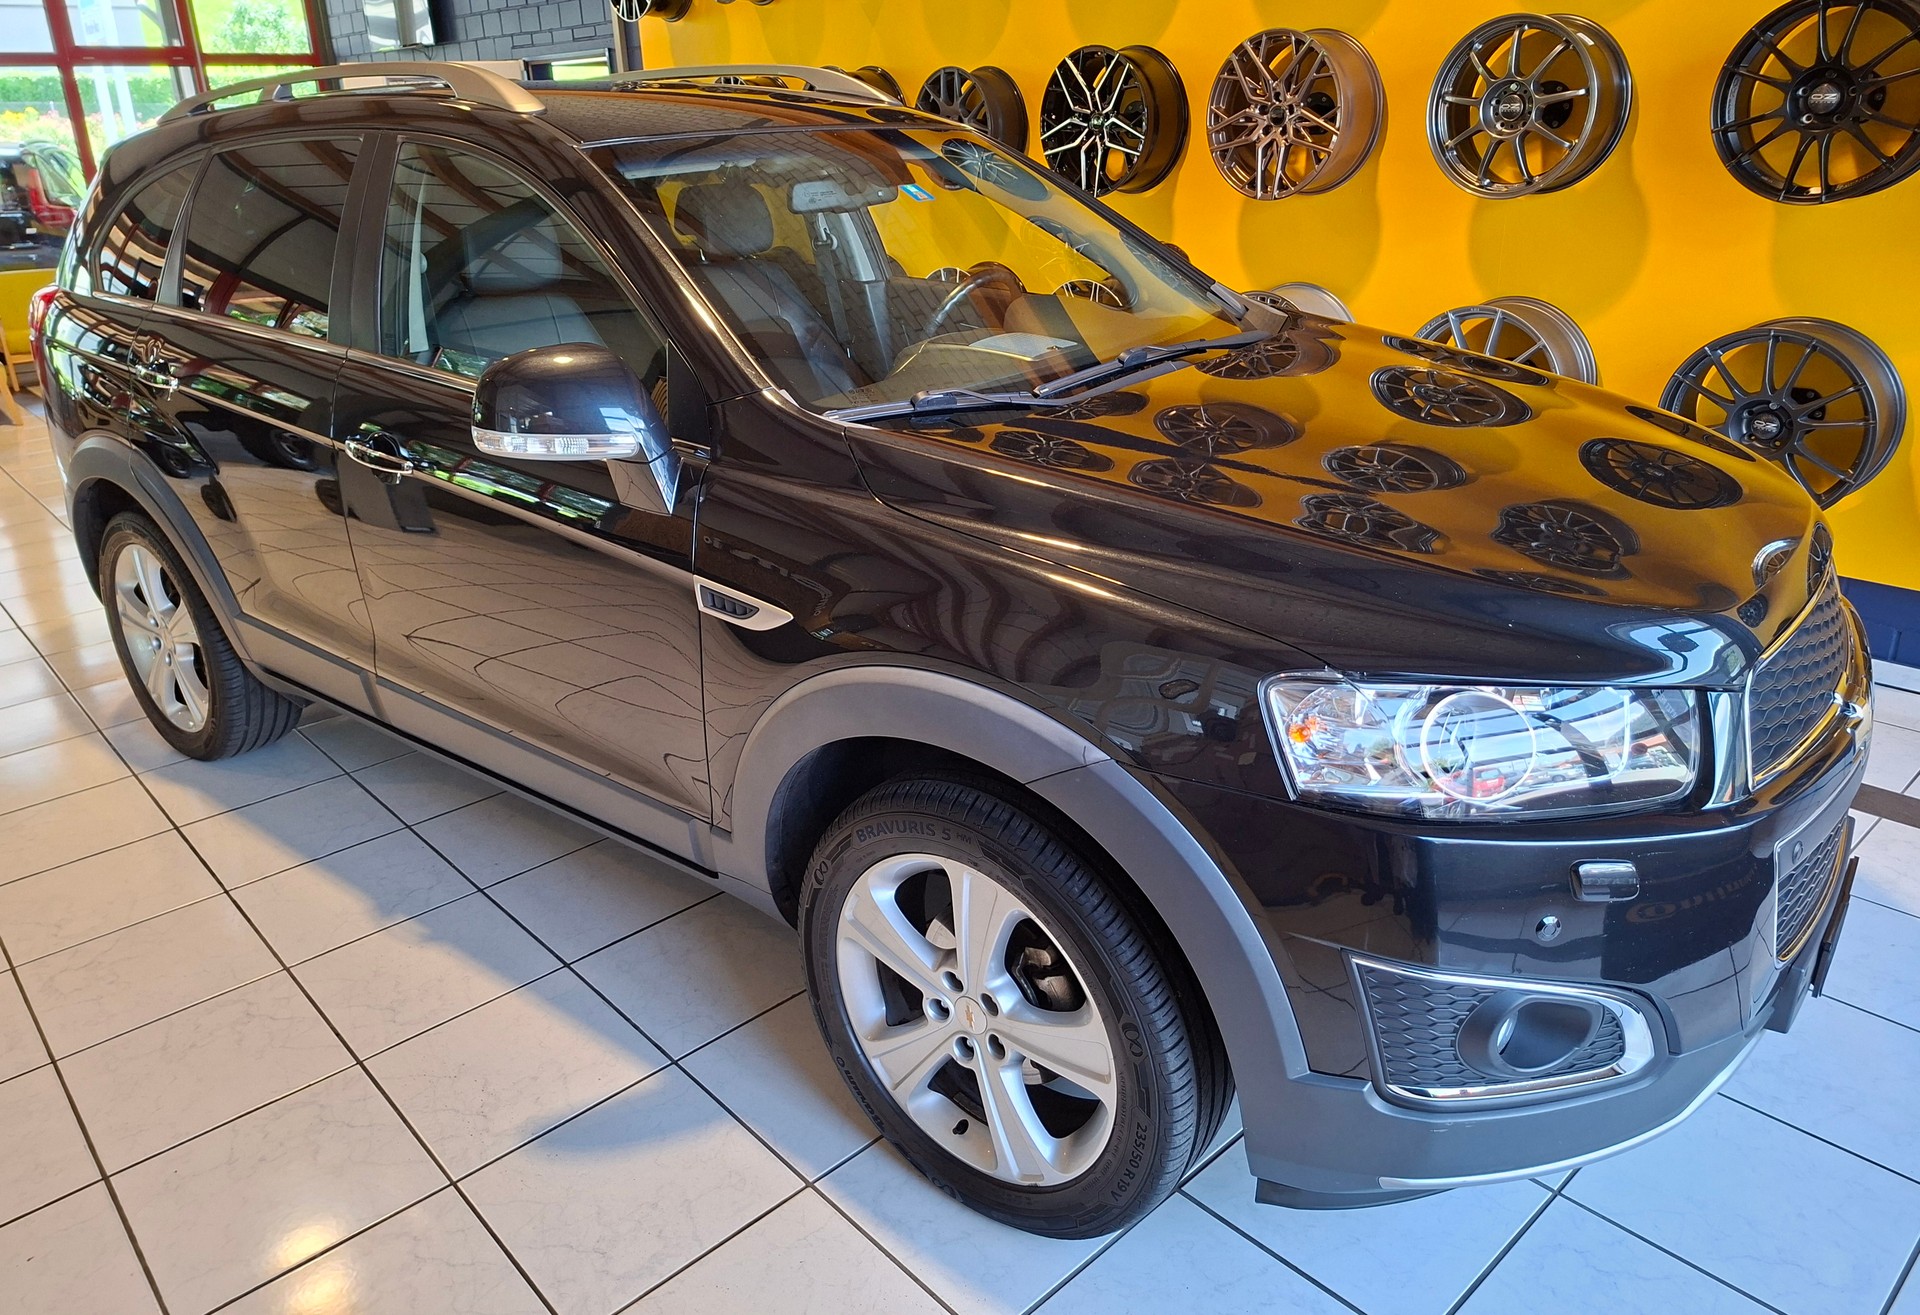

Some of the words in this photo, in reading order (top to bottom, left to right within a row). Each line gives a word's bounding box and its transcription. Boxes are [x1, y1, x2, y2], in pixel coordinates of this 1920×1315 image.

[855, 820, 936, 843] BRAVURIS
[941, 828, 952, 841] 5
[1129, 1121, 1148, 1169] 235/50
[1123, 1168, 1136, 1180] R
[1117, 1179, 1131, 1193] 19
[1110, 1190, 1123, 1202] V
